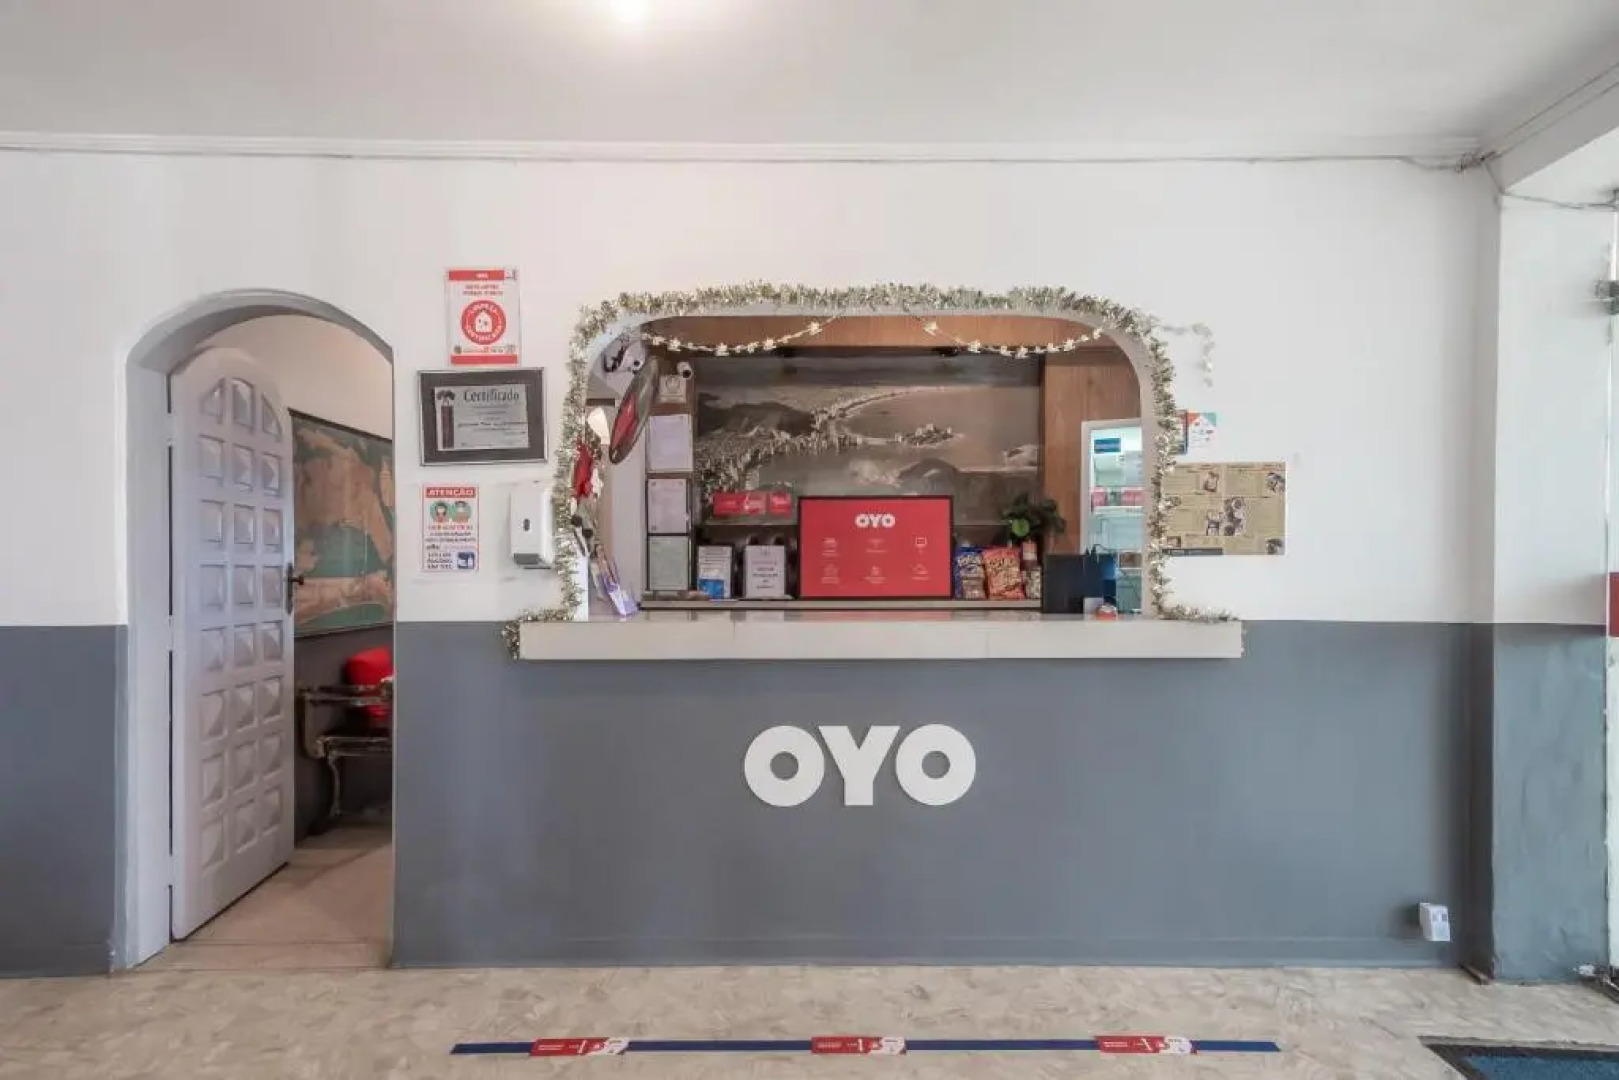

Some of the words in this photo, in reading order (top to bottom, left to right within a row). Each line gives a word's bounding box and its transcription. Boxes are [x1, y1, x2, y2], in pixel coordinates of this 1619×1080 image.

[463, 388, 520, 403] Certificado
[427, 487, 474, 498] ATENÇÃO
[855, 513, 896, 528] OYO
[744, 723, 976, 807] OYO
